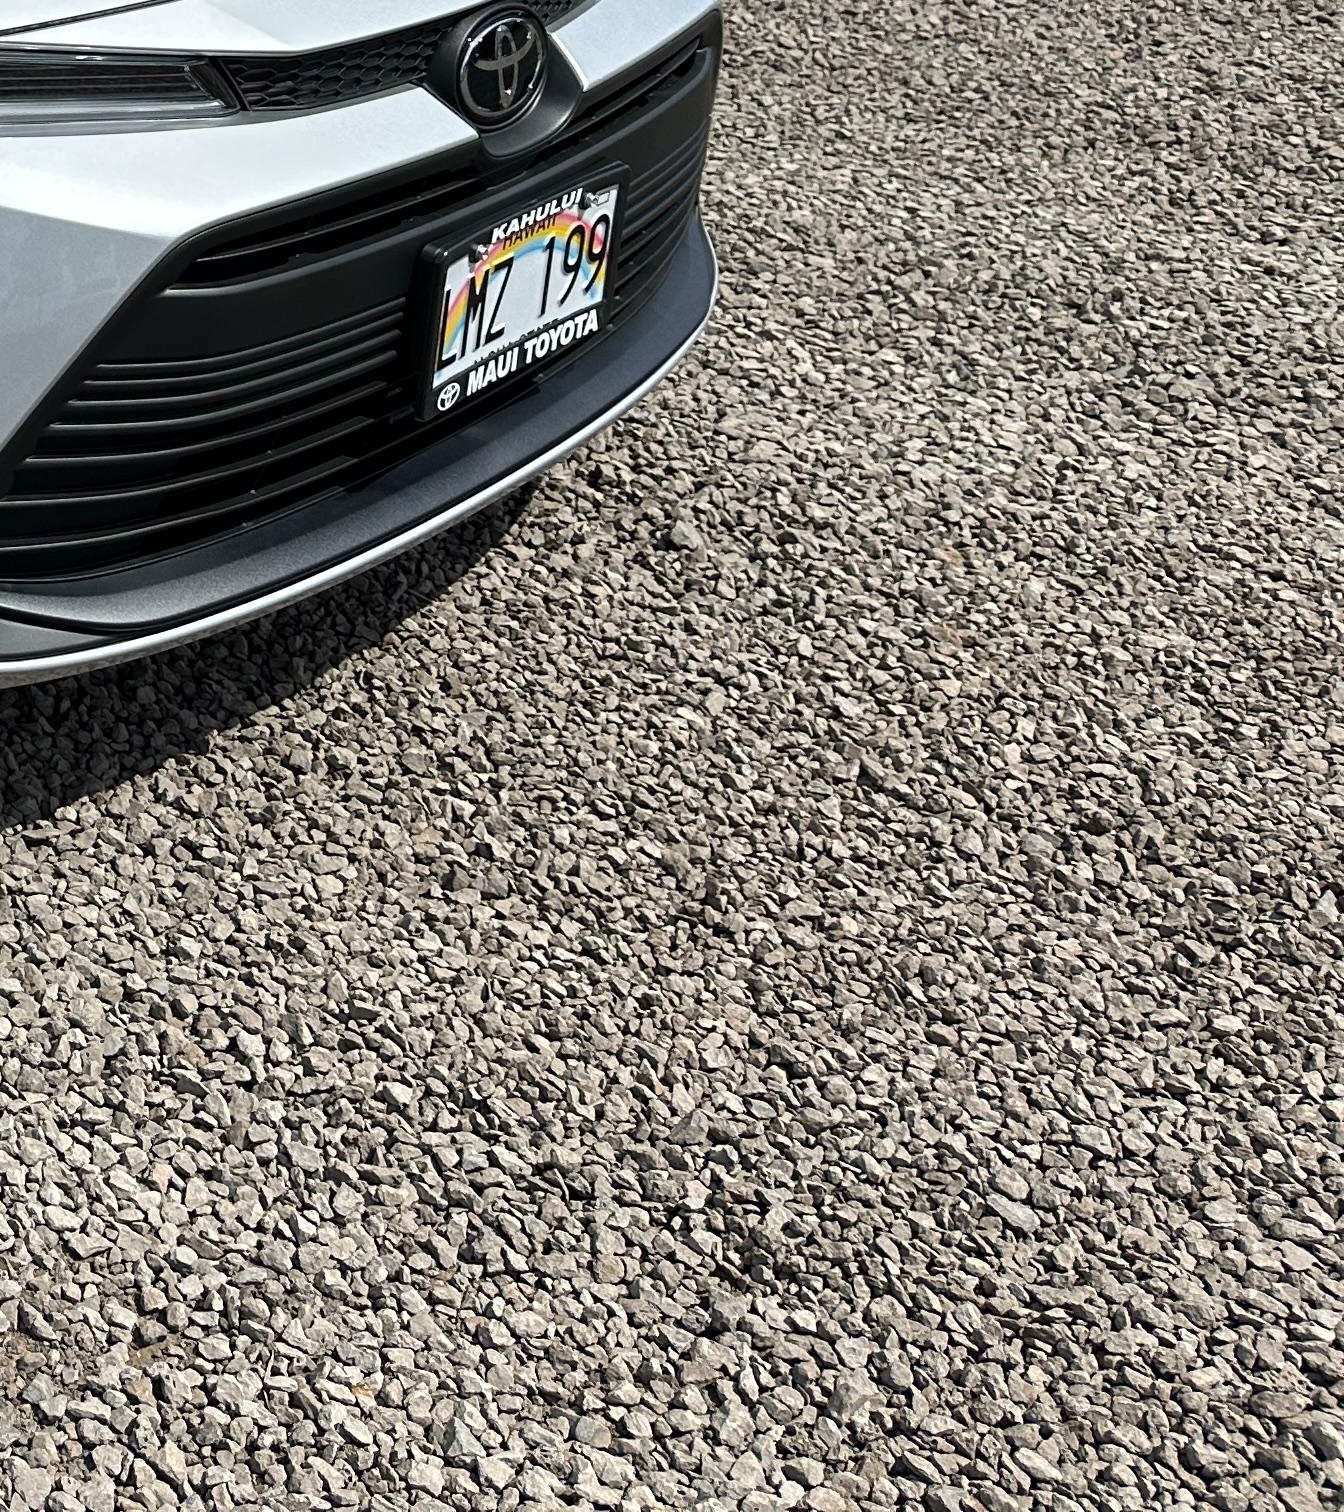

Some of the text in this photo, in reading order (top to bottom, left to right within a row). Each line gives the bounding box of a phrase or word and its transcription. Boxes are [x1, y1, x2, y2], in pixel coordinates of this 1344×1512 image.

[491, 187, 583, 244] KAHULUI
[503, 214, 557, 250] HAWAII
[438, 255, 514, 372] LMZ
[537, 213, 612, 319] 199
[466, 346, 519, 397] MAUI
[524, 308, 599, 364] TOYOTA
